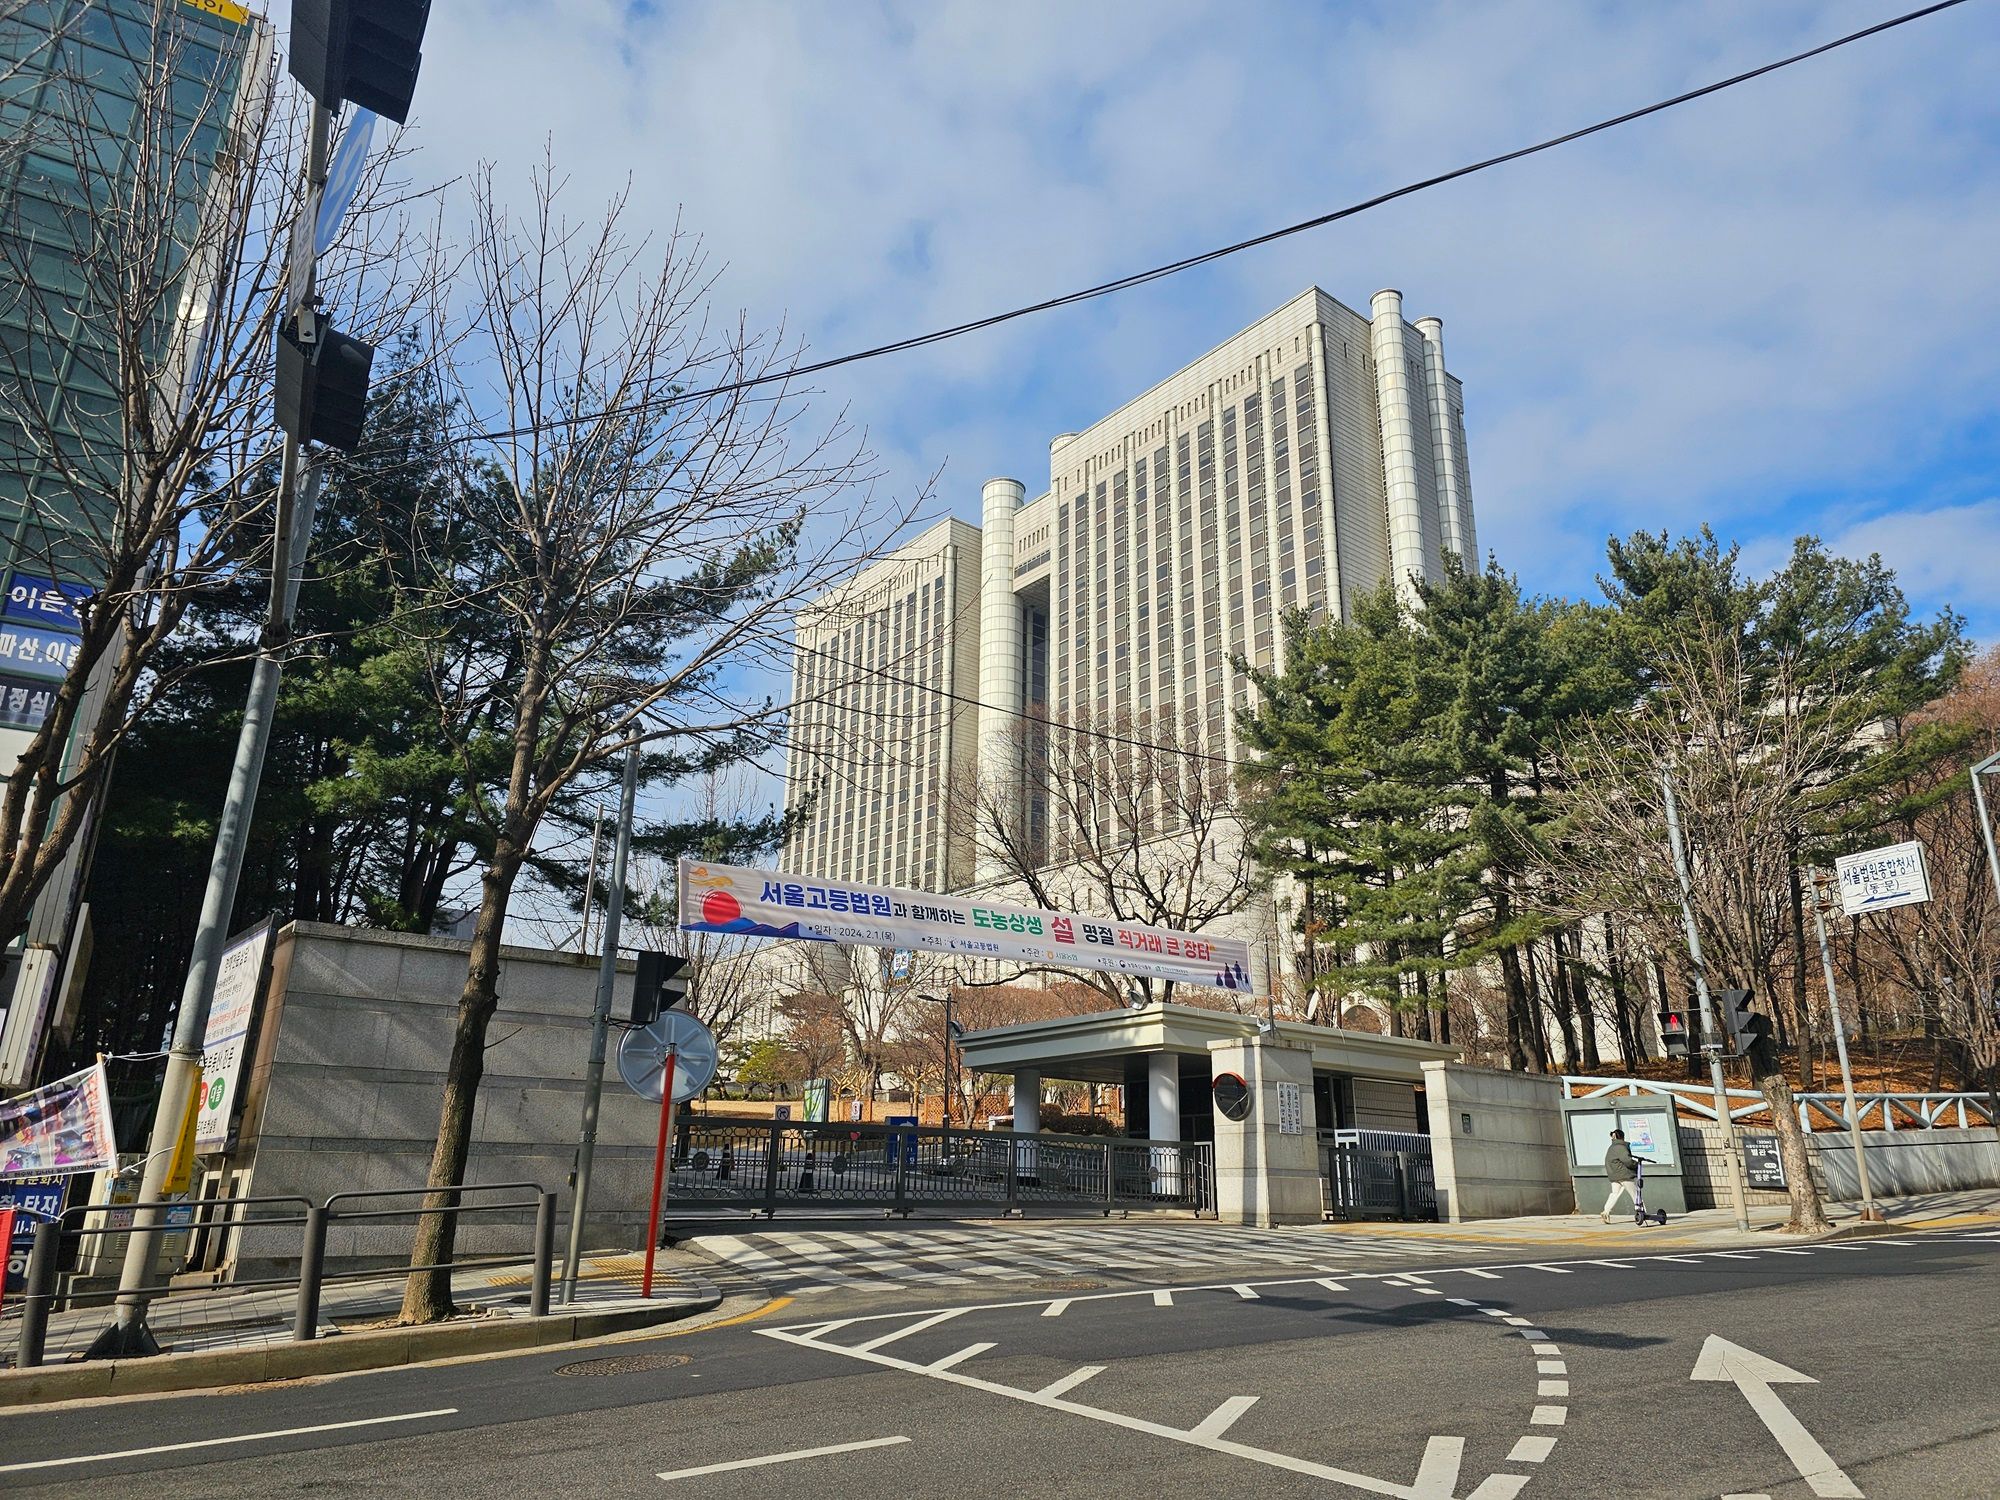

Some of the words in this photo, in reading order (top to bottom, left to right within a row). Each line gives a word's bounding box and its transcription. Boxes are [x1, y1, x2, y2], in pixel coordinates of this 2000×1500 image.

[11, 585, 97, 619] 이은
[1843, 856, 1915, 885] 서울법원종합청사
[814, 924, 831, 935] 일자
[839, 927, 864, 938] 2024.
[911, 904, 966, 925] 함께하는
[972, 908, 1044, 935] 도농상생
[1051, 916, 1076, 945] 설
[1082, 923, 1115, 946] 명절
[1118, 929, 1162, 953] 직거래
[1166, 936, 1180, 956] 큰
[1184, 940, 1211, 961] 장터
[927, 936, 943, 946] 주최
[959, 939, 1000, 952] 서울고등법원
[1026, 947, 1040, 958] 주관
